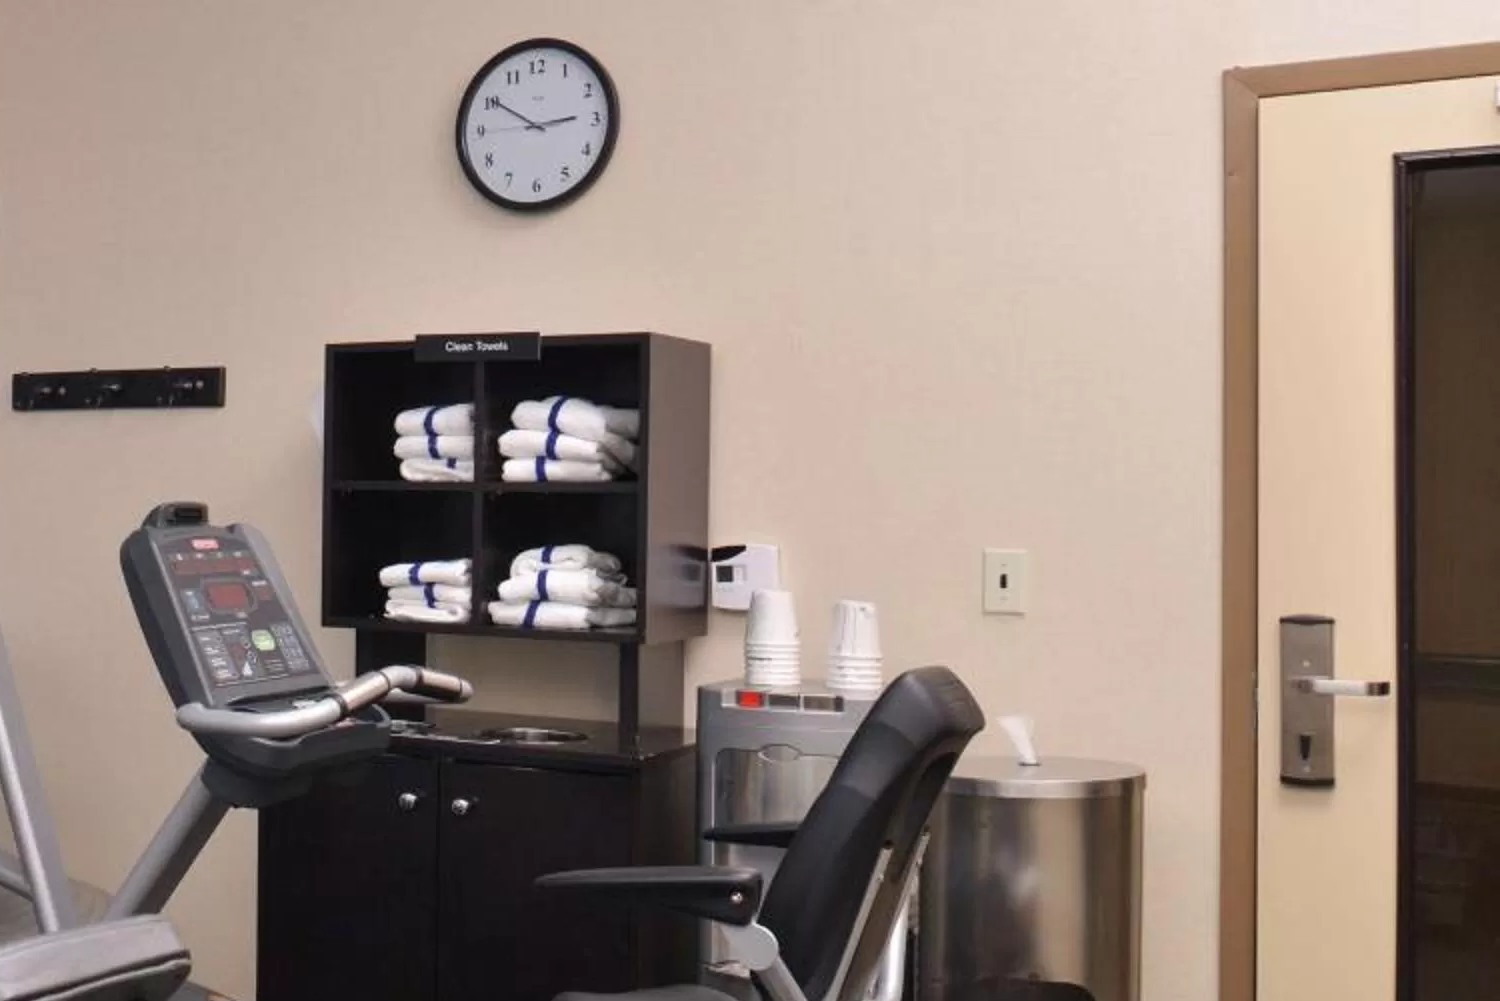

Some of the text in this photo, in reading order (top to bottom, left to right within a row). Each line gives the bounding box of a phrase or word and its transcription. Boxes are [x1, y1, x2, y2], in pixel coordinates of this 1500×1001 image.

[529, 59, 546, 75] 12
[562, 63, 568, 78] 1
[506, 70, 520, 85] 11
[583, 83, 593, 98] 2
[484, 96, 500, 111] 10
[590, 111, 601, 127] 3
[477, 124, 486, 137] 9
[581, 141, 591, 157] 4
[485, 152, 494, 168] 8
[504, 172, 513, 188] 7
[560, 167, 571, 182] 5
[532, 178, 542, 193] 6
[444, 341, 473, 352] Clean
